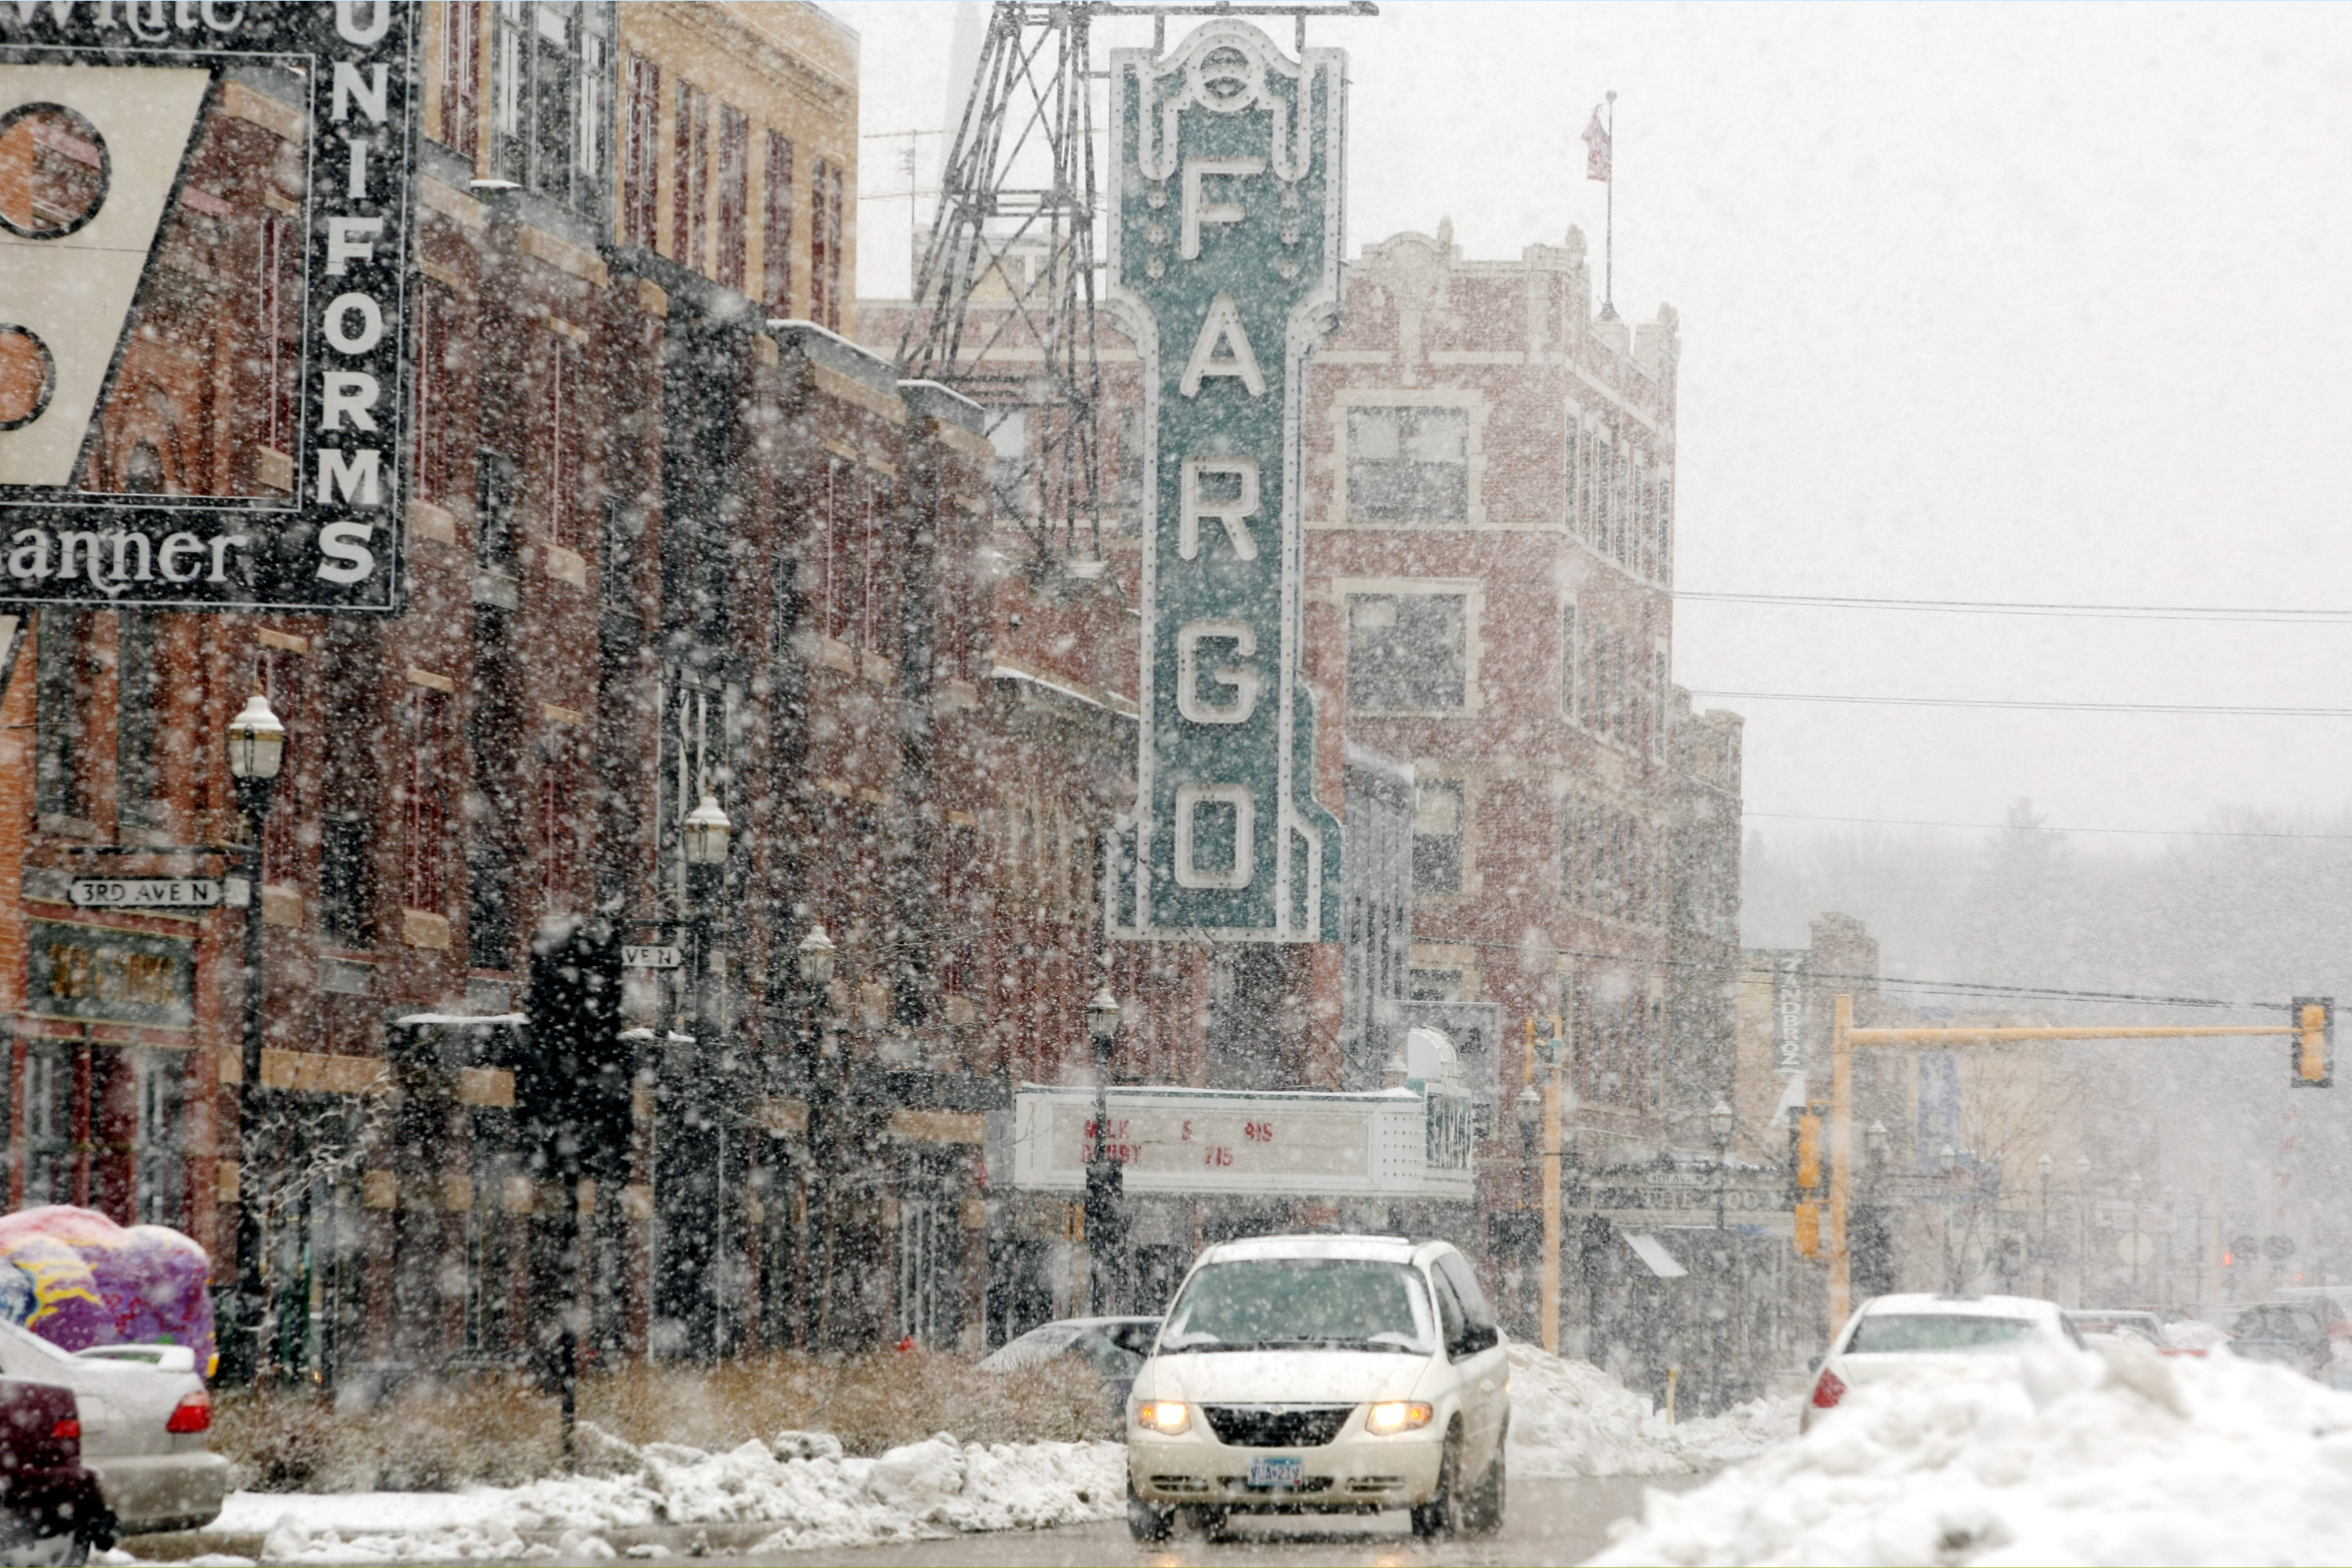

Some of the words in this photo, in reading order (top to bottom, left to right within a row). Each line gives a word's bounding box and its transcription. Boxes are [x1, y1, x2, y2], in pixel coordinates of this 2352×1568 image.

[315, 0, 391, 584] UNIFORMS
[1174, 155, 1267, 891] FARGO
[82, 883, 125, 902] 3RD
[135, 883, 180, 902] AVE
[192, 883, 208, 901] N
[658, 949, 671, 964] N
[1779, 957, 1802, 1065] ZANDBROZ
[1085, 1120, 1129, 1139] MLK
[1081, 1144, 1142, 1164] DUBT
